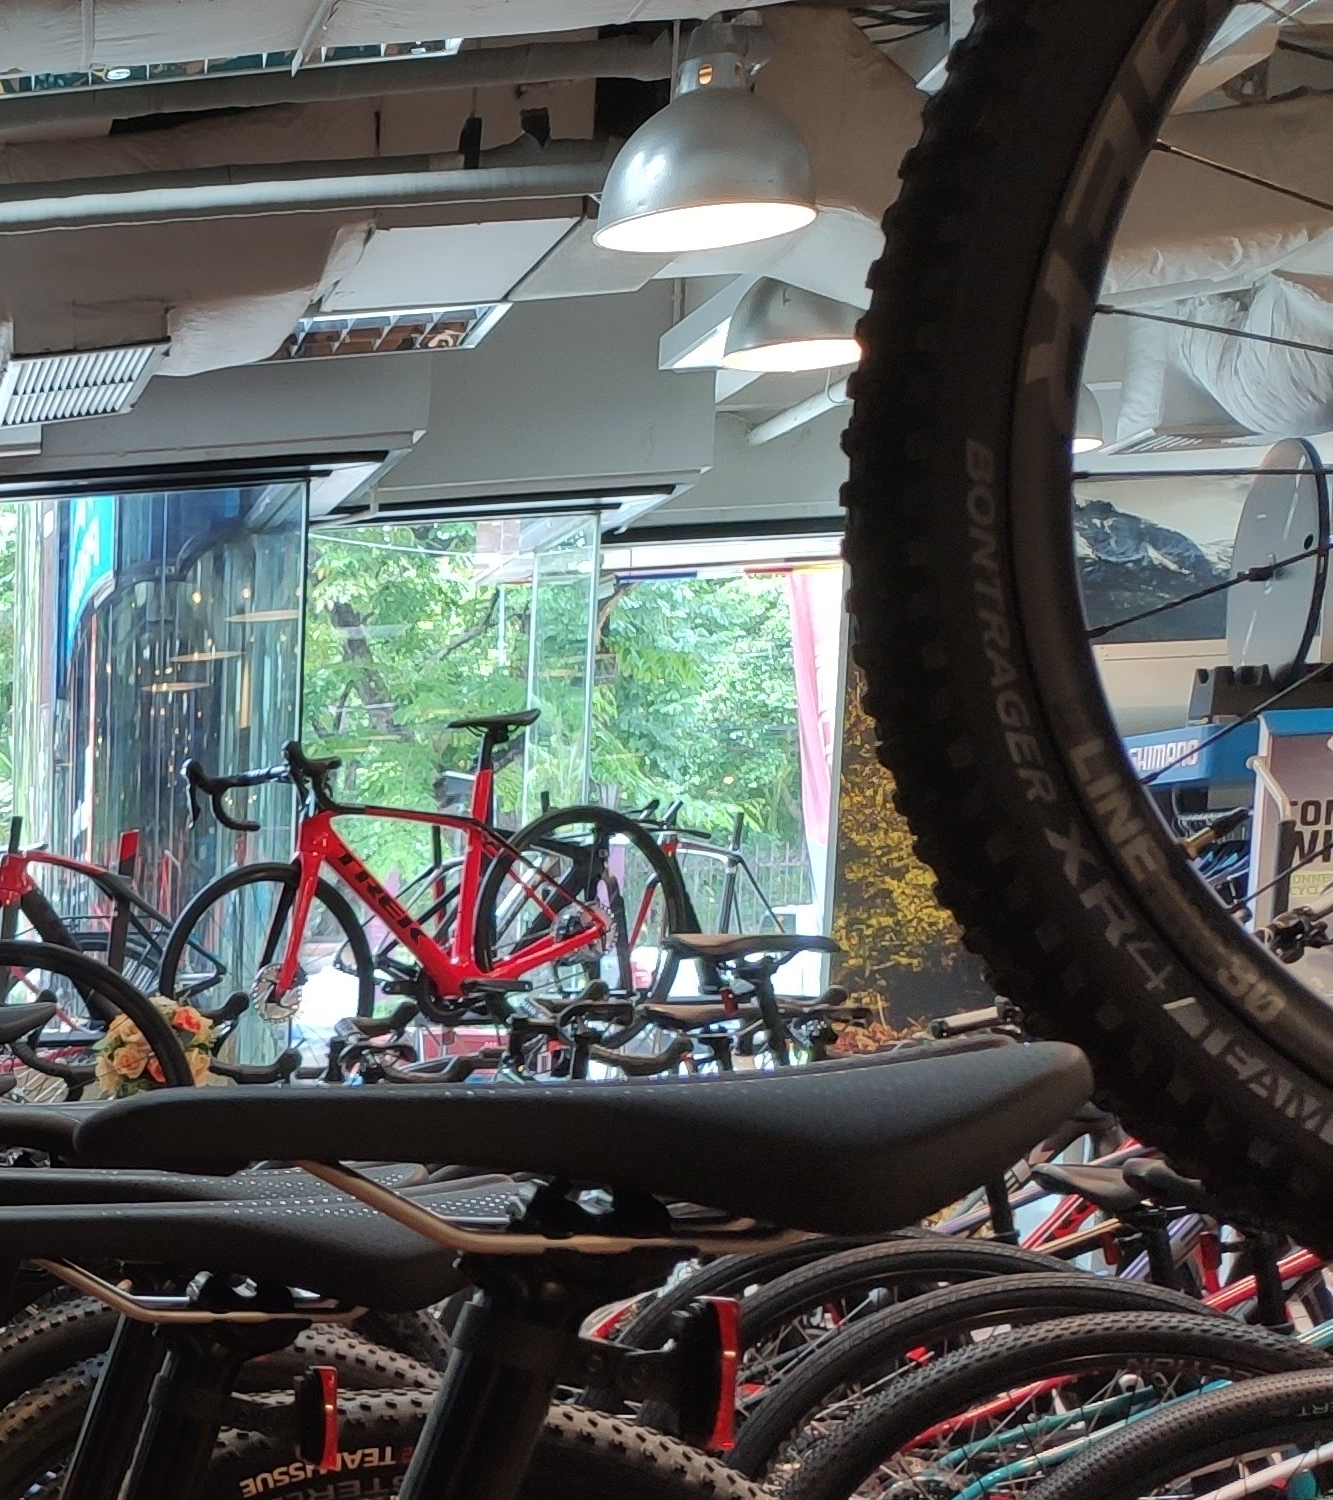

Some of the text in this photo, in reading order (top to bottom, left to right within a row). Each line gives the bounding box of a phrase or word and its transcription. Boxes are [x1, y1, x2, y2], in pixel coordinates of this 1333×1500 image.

[965, 438, 1057, 802] BONTRAGER
[1042, 822, 1173, 992] XR4
[1069, 740, 1167, 883] LINE
[238, 1461, 309, 1499] ISSUE
